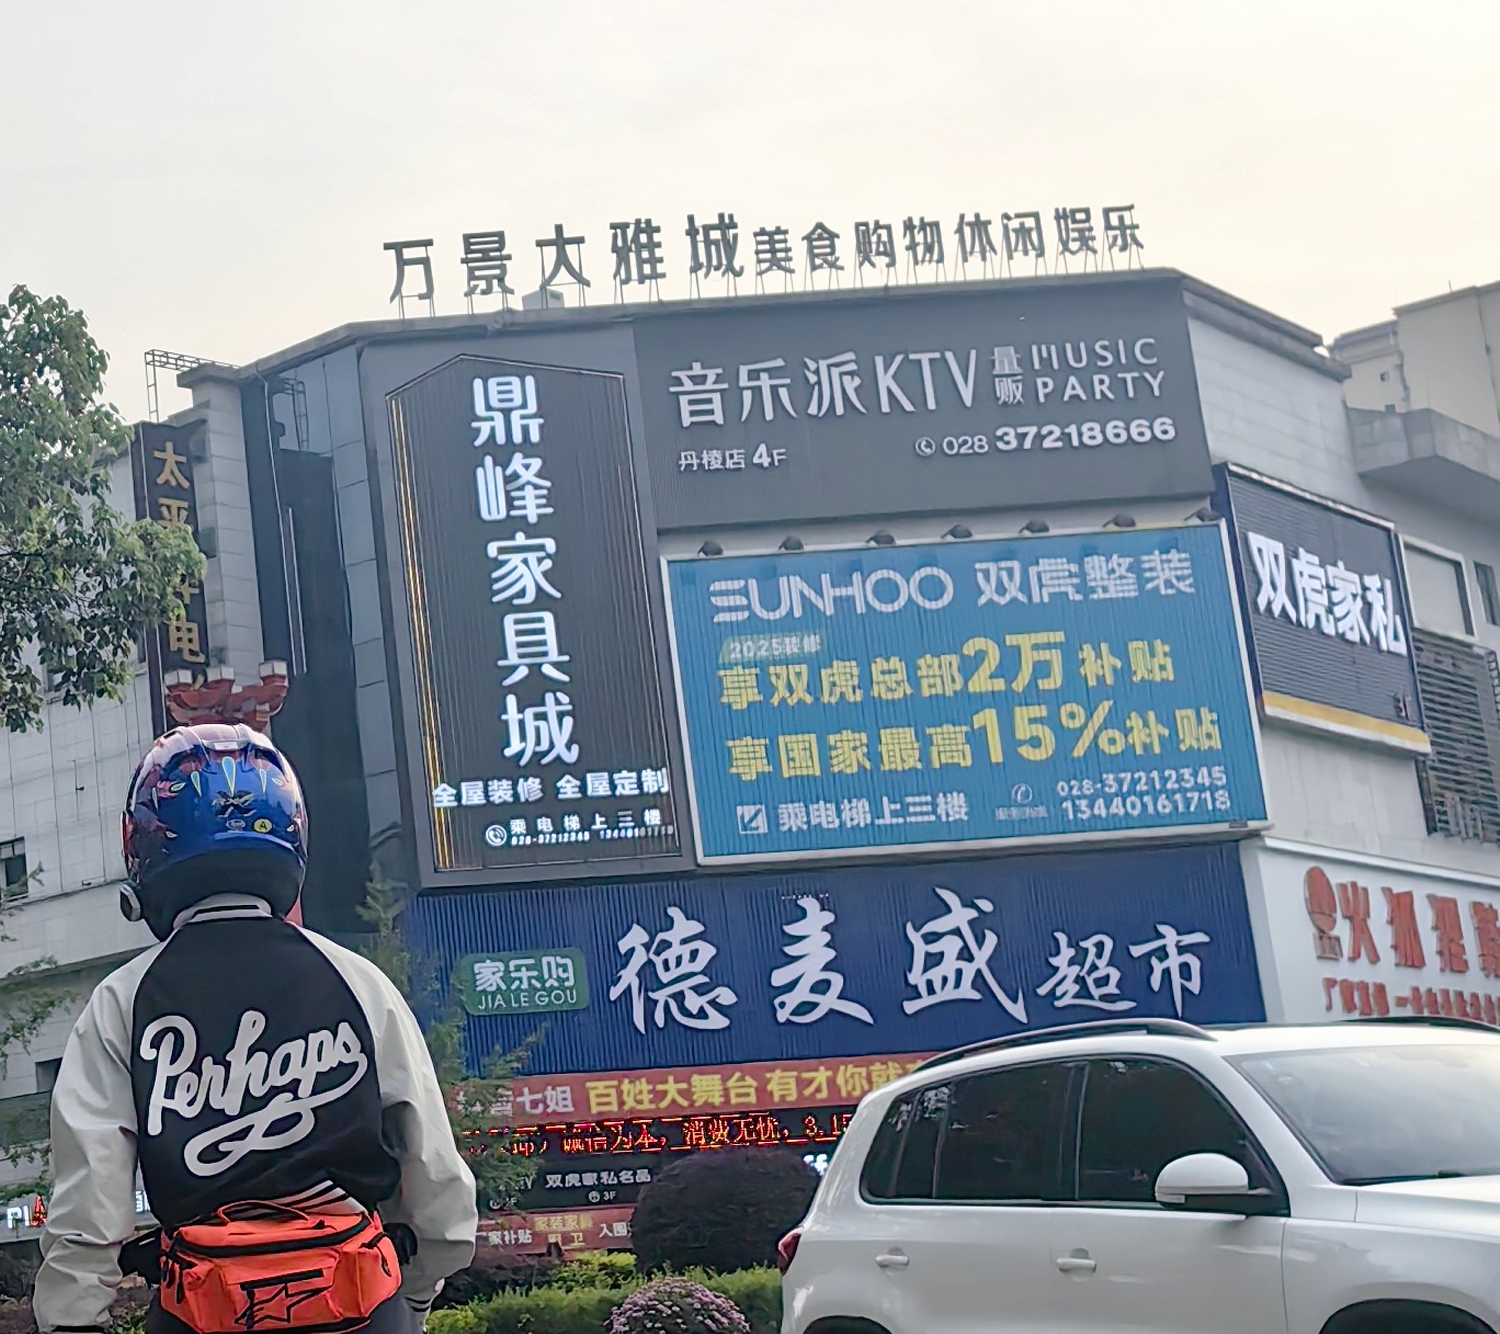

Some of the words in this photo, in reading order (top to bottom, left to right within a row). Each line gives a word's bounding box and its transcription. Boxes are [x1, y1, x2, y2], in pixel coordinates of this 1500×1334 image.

[1031, 337, 1158, 371] MUSIC
[668, 349, 977, 427] 音乐派KTV
[1036, 370, 1164, 403] PARTY
[942, 435, 989, 455] 028
[995, 417, 1176, 452] 37218666
[678, 450, 745, 472] 丹棱店
[752, 444, 787, 469] 4F
[471, 375, 579, 766] 鼎峰家具城
[975, 549, 1195, 607] 双虎整装
[1248, 531, 1407, 656] 双虎家私
[717, 631, 1174, 710] 享双虎总部2万补贴
[725, 699, 1223, 781] 享国家最高15%补贴
[432, 777, 543, 808] 全屋装修
[556, 767, 669, 800] 全屋定制
[1057, 766, 1227, 796] 028-37212345
[778, 792, 969, 832] 乘电梯上三楼
[1062, 790, 1230, 820] 13440161718
[474, 956, 575, 991] 家乐购
[609, 887, 1211, 1034] 德麦盛超市
[478, 993, 506, 1010] JIA
[510, 992, 529, 1007] LE
[535, 988, 577, 1005] GOU
[140, 1010, 368, 1142] Perhaps
[586, 1072, 758, 1114] 百姓大舞台
[766, 1060, 924, 1103] 有才你就
[476, 1229, 532, 1246] 家补贴
